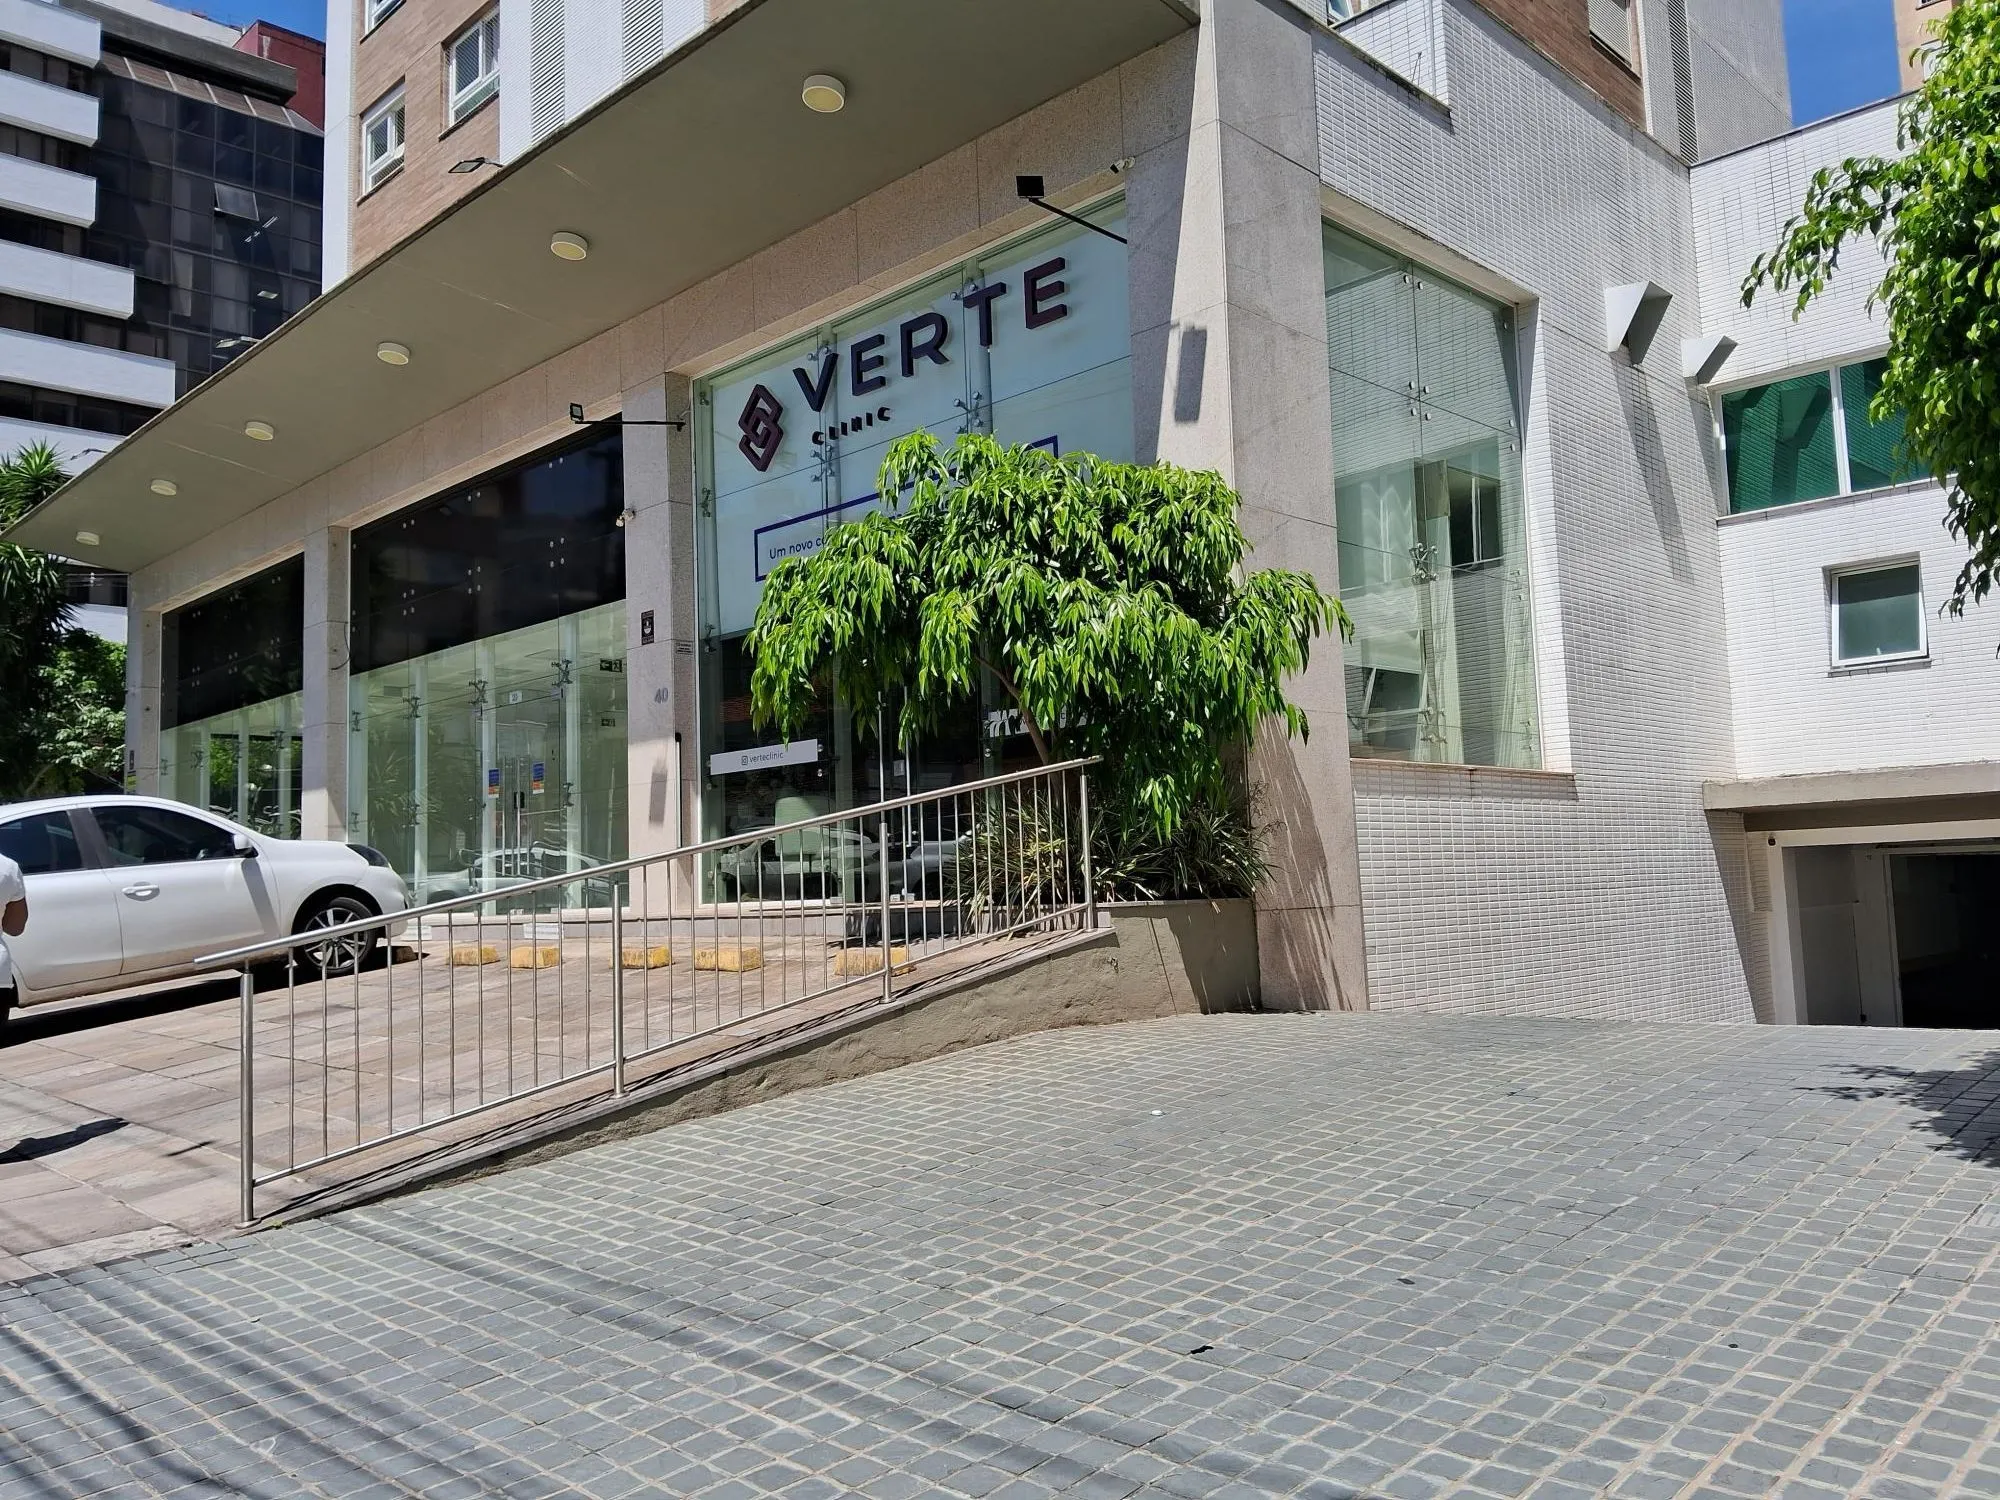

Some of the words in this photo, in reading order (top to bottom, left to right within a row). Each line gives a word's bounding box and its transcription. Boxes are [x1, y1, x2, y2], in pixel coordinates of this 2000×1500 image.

[792, 256, 1068, 412] VERTE
[811, 406, 892, 446] CLINIC
[769, 547, 786, 560] Um
[789, 540, 813, 554] novo
[654, 687, 669, 704] 40
[749, 751, 784, 763] verteclinic
